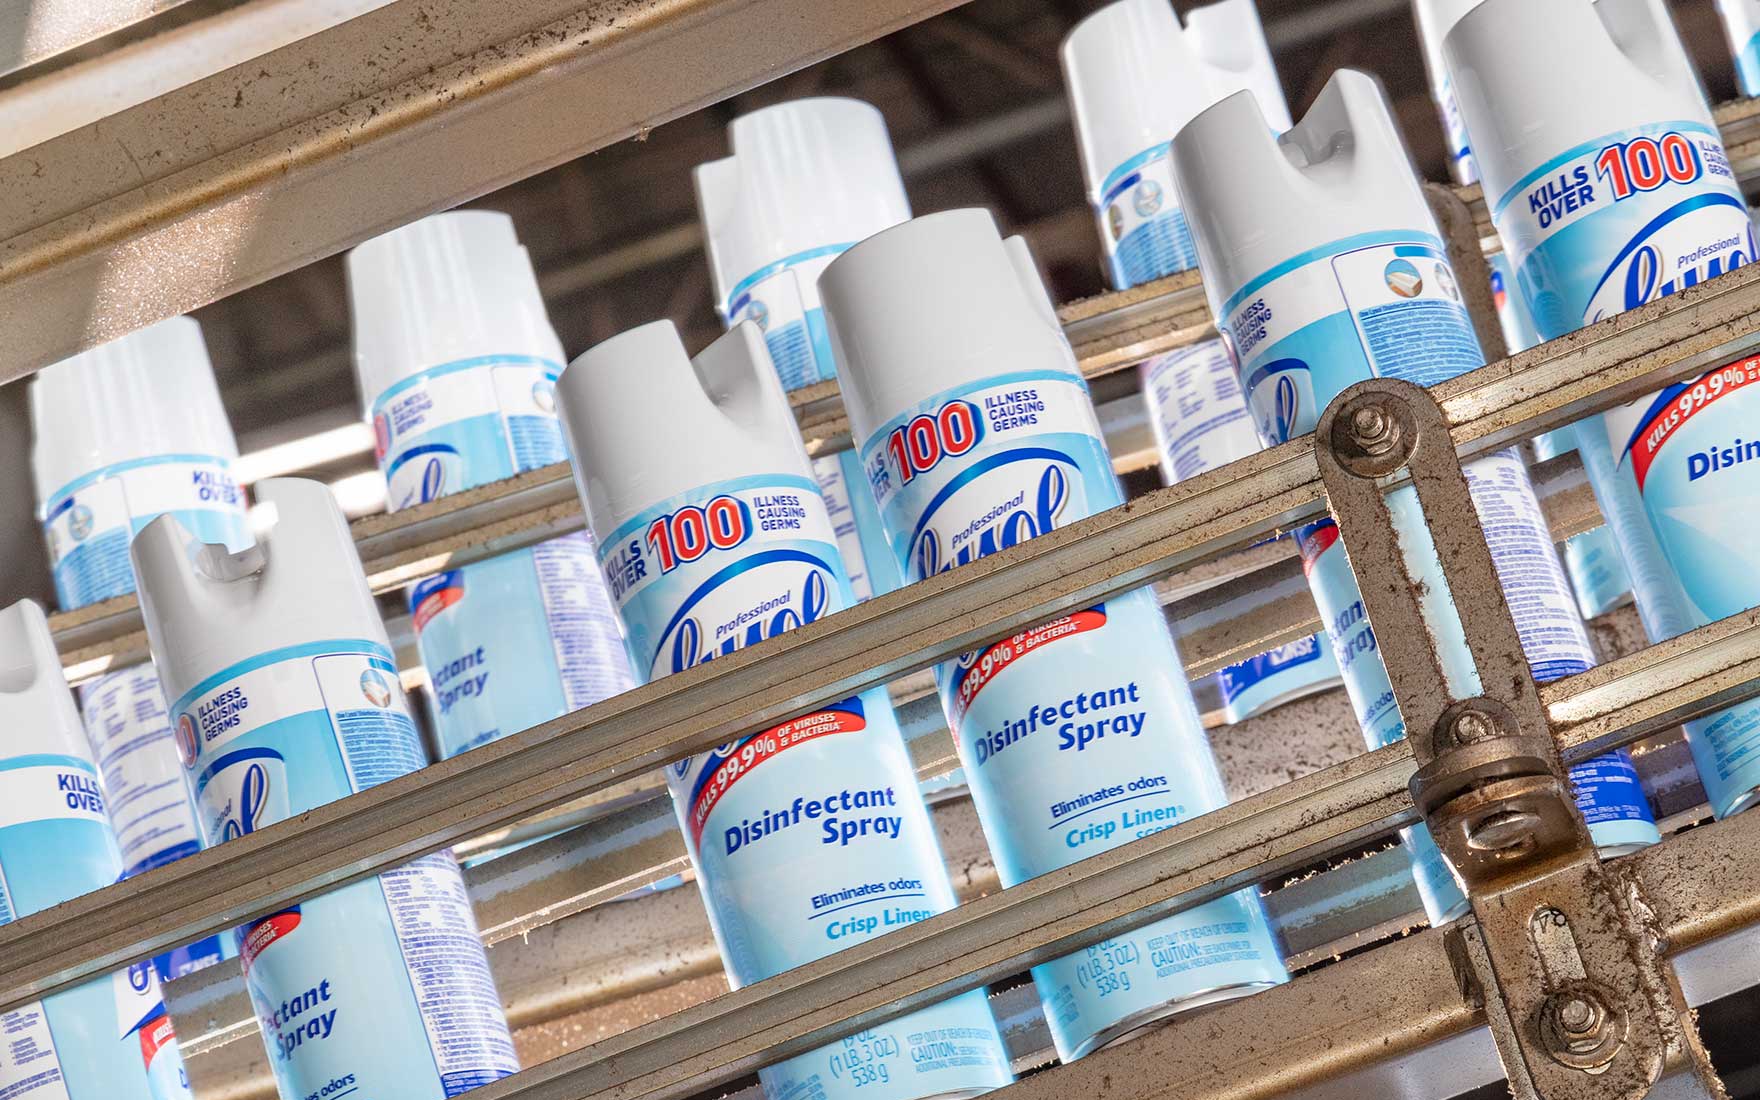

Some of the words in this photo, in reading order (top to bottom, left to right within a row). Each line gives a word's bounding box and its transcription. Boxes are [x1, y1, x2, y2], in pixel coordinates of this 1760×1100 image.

[1594, 131, 1703, 202] 100
[1528, 165, 1589, 213] KILLS
[1538, 184, 1595, 229] OVER
[1678, 234, 1741, 269] Professional
[985, 389, 1038, 409] ILLNESS
[989, 401, 1045, 421] CAUSING
[1647, 409, 1681, 453] KILLS
[1679, 367, 1745, 417] 99.9%
[993, 414, 1038, 433] GERMS
[887, 399, 986, 487] 100
[753, 495, 800, 508] ILLNESS
[757, 507, 806, 520] CAUSING
[645, 495, 753, 575] 100
[761, 519, 801, 531] GERMS
[952, 491, 1025, 549] Professional
[604, 539, 640, 584] KILLS
[612, 560, 648, 601] OVER
[716, 590, 791, 639] Professional
[961, 645, 1012, 702] 99.9%
[198, 687, 242, 719] ILLNESS
[201, 698, 249, 731] CAUSING
[204, 716, 242, 742] GERMS
[777, 723, 791, 738] OF
[793, 713, 837, 731] VIRUSES
[974, 682, 1140, 767] Disinfectant
[1058, 712, 1146, 752] Spray
[780, 736, 789, 747] &
[716, 736, 777, 792] 99.9%
[57, 773, 98, 796] KILLS
[1051, 784, 1124, 819] Eliminates
[1127, 775, 1168, 792] odors
[724, 787, 896, 856] Disinfectant
[822, 816, 902, 846] Spray
[1066, 820, 1117, 849] Crisp
[811, 882, 886, 910] Eliminates
[888, 878, 923, 892] odors
[826, 915, 879, 941] Crisp
[1107, 950, 1115, 972] 3
[1097, 973, 1119, 997] 538
[1119, 971, 1131, 991] g
[276, 1008, 337, 1061] Spray
[863, 1043, 874, 1062] 3
[911, 1040, 958, 1062] CAUTION:
[320, 1073, 355, 1097] odors
[851, 1063, 877, 1087] 538
[879, 1066, 890, 1083] g
